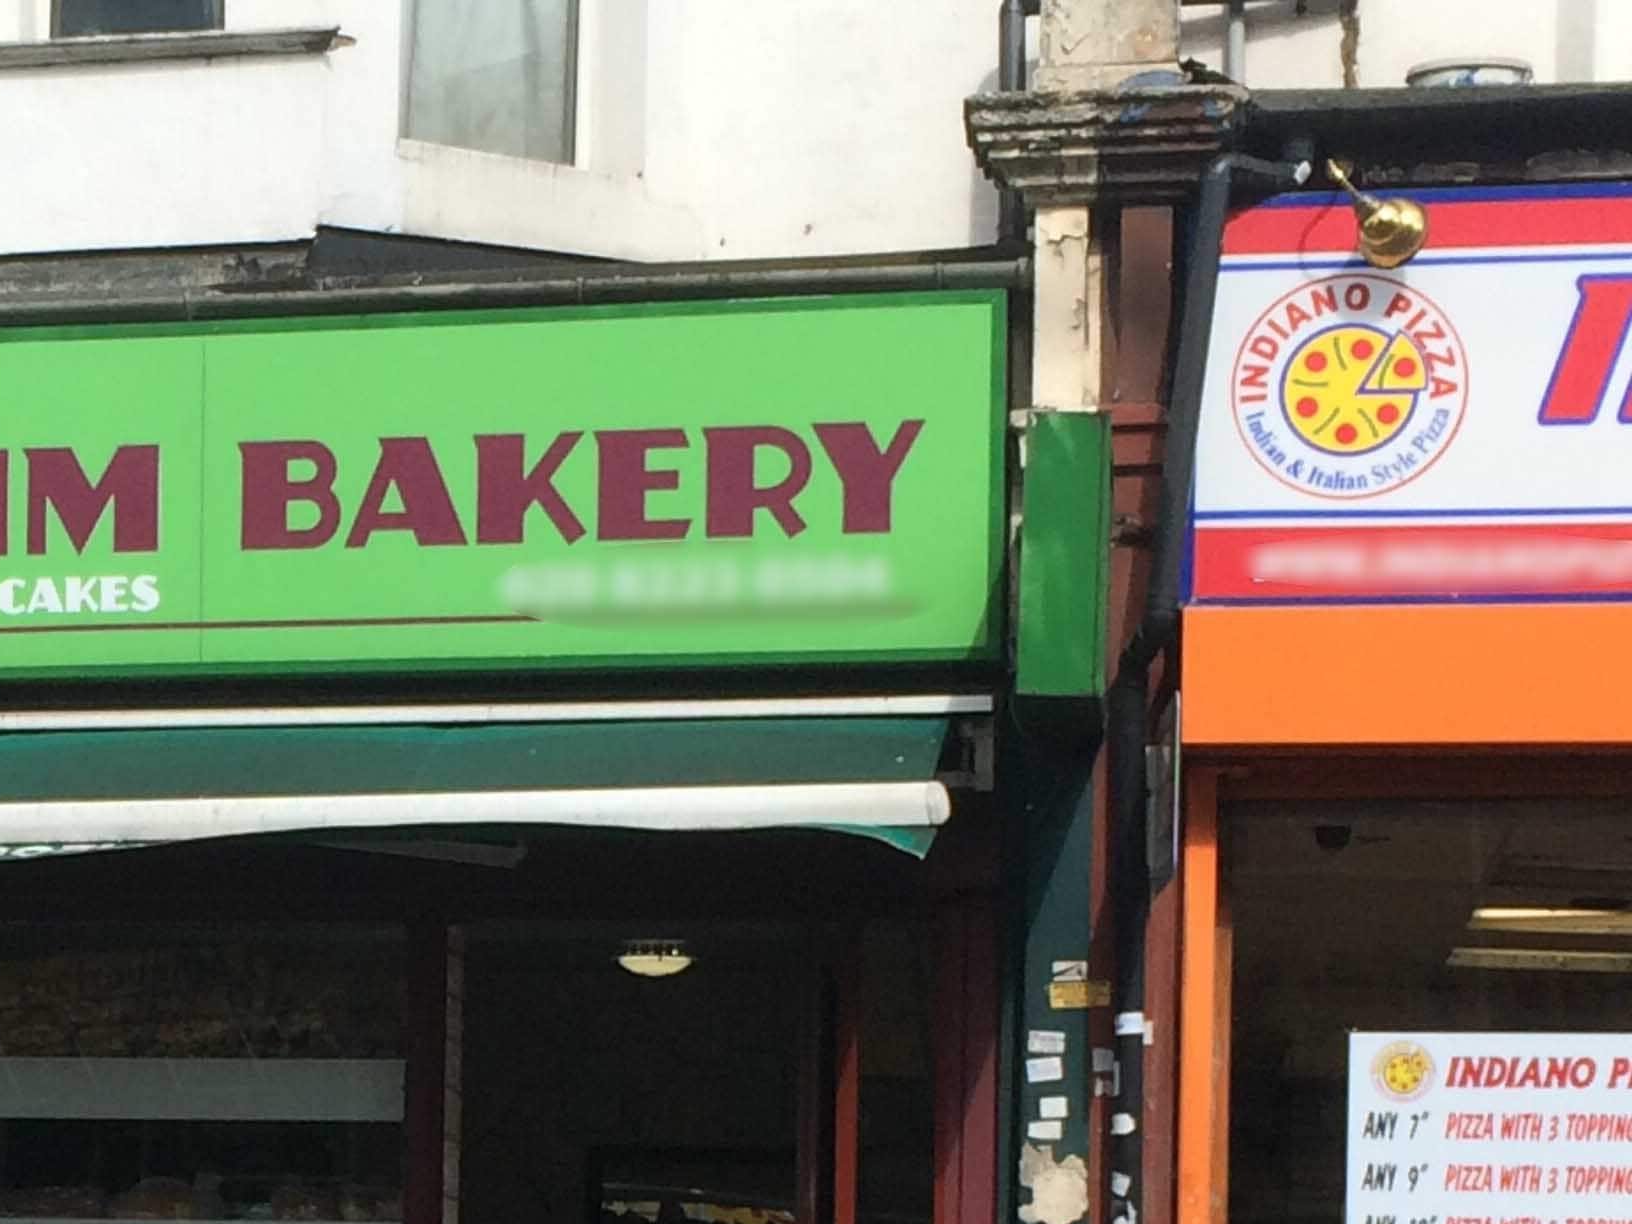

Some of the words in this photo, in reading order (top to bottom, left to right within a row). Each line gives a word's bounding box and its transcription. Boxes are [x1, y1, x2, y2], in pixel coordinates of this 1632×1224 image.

[1240, 283, 1370, 404] INDIANO
[1384, 292, 1458, 400] PIZZA
[1537, 273, 1632, 425] I
[238, 419, 925, 550] BAKERY
[1246, 411, 1288, 466] Indian
[1286, 460, 1305, 478] &
[1307, 466, 1369, 490] Italian
[1370, 451, 1417, 486] Style
[1412, 408, 1450, 453] Pizza
[1445, 1056, 1597, 1088] INDIANO
[1606, 1056, 1632, 1089] P
[1363, 1112, 1398, 1140] ANY
[1445, 1112, 1493, 1140] PIZZA
[1501, 1113, 1542, 1141] WITH
[1548, 1115, 1559, 1141] 3
[1362, 1164, 1397, 1192] ANY
[1445, 1164, 1492, 1192] PIZZA
[1500, 1165, 1541, 1193] WITH
[1547, 1167, 1559, 1194] 3
